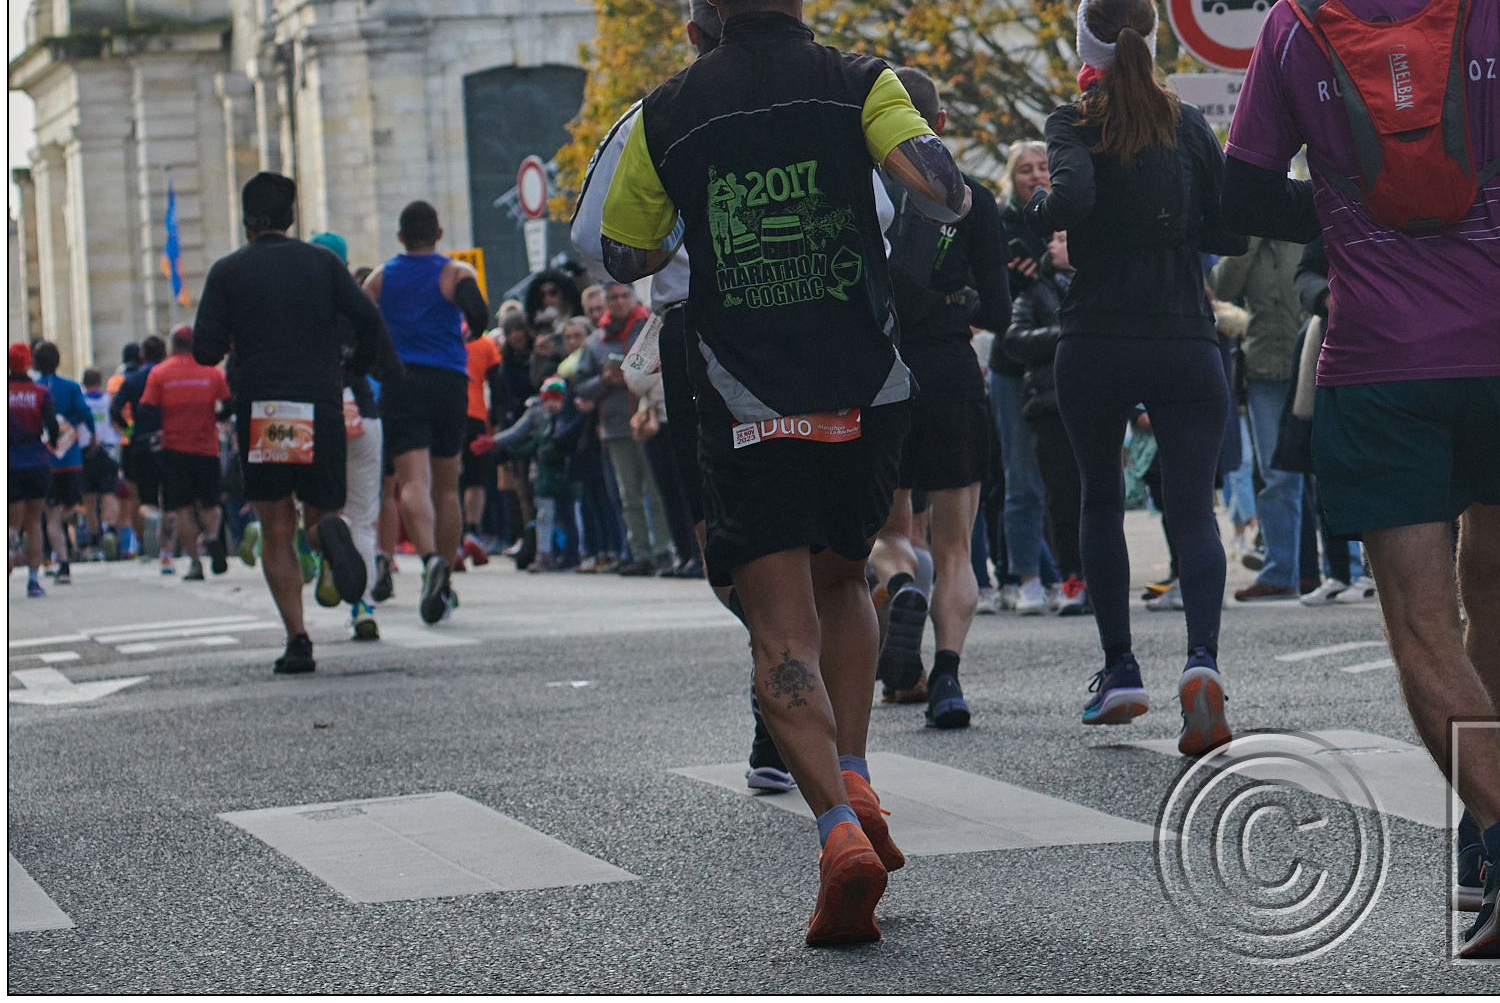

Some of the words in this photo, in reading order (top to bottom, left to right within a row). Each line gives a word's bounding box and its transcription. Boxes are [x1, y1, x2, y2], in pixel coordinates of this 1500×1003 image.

[744, 160, 818, 207] 2017
[716, 253, 828, 292] MARATHON
[745, 276, 825, 309] COGNAC
[737, 434, 756, 446] 2023
[761, 418, 812, 437] Duo
